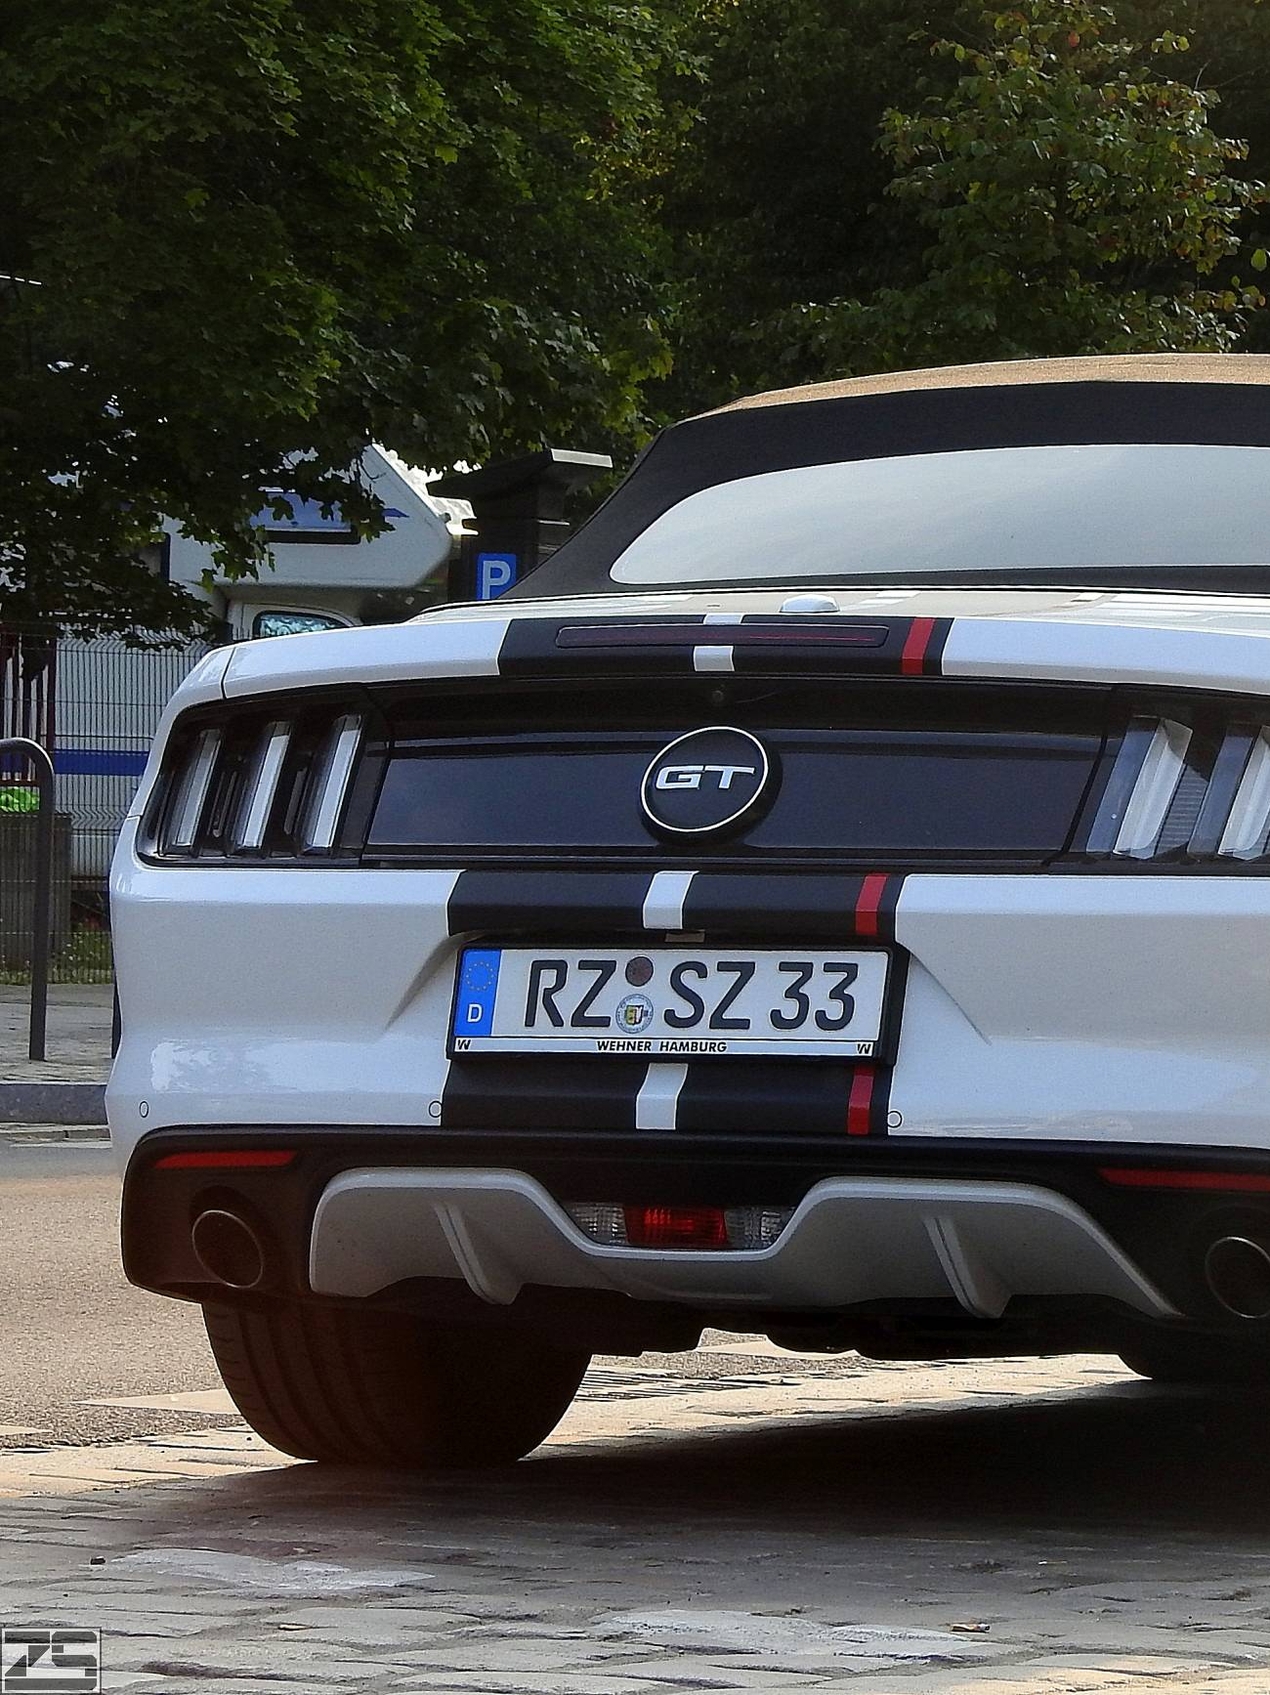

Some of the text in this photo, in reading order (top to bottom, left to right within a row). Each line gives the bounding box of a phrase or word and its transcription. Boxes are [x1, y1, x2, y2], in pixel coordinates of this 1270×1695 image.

[482, 560, 511, 599] P
[656, 765, 755, 789] GT
[524, 960, 617, 1027] RZ
[663, 962, 756, 1030] SZ
[769, 962, 859, 1031] 33
[467, 1004, 482, 1023] D
[597, 1040, 727, 1053] WEHNER HAMBURG
